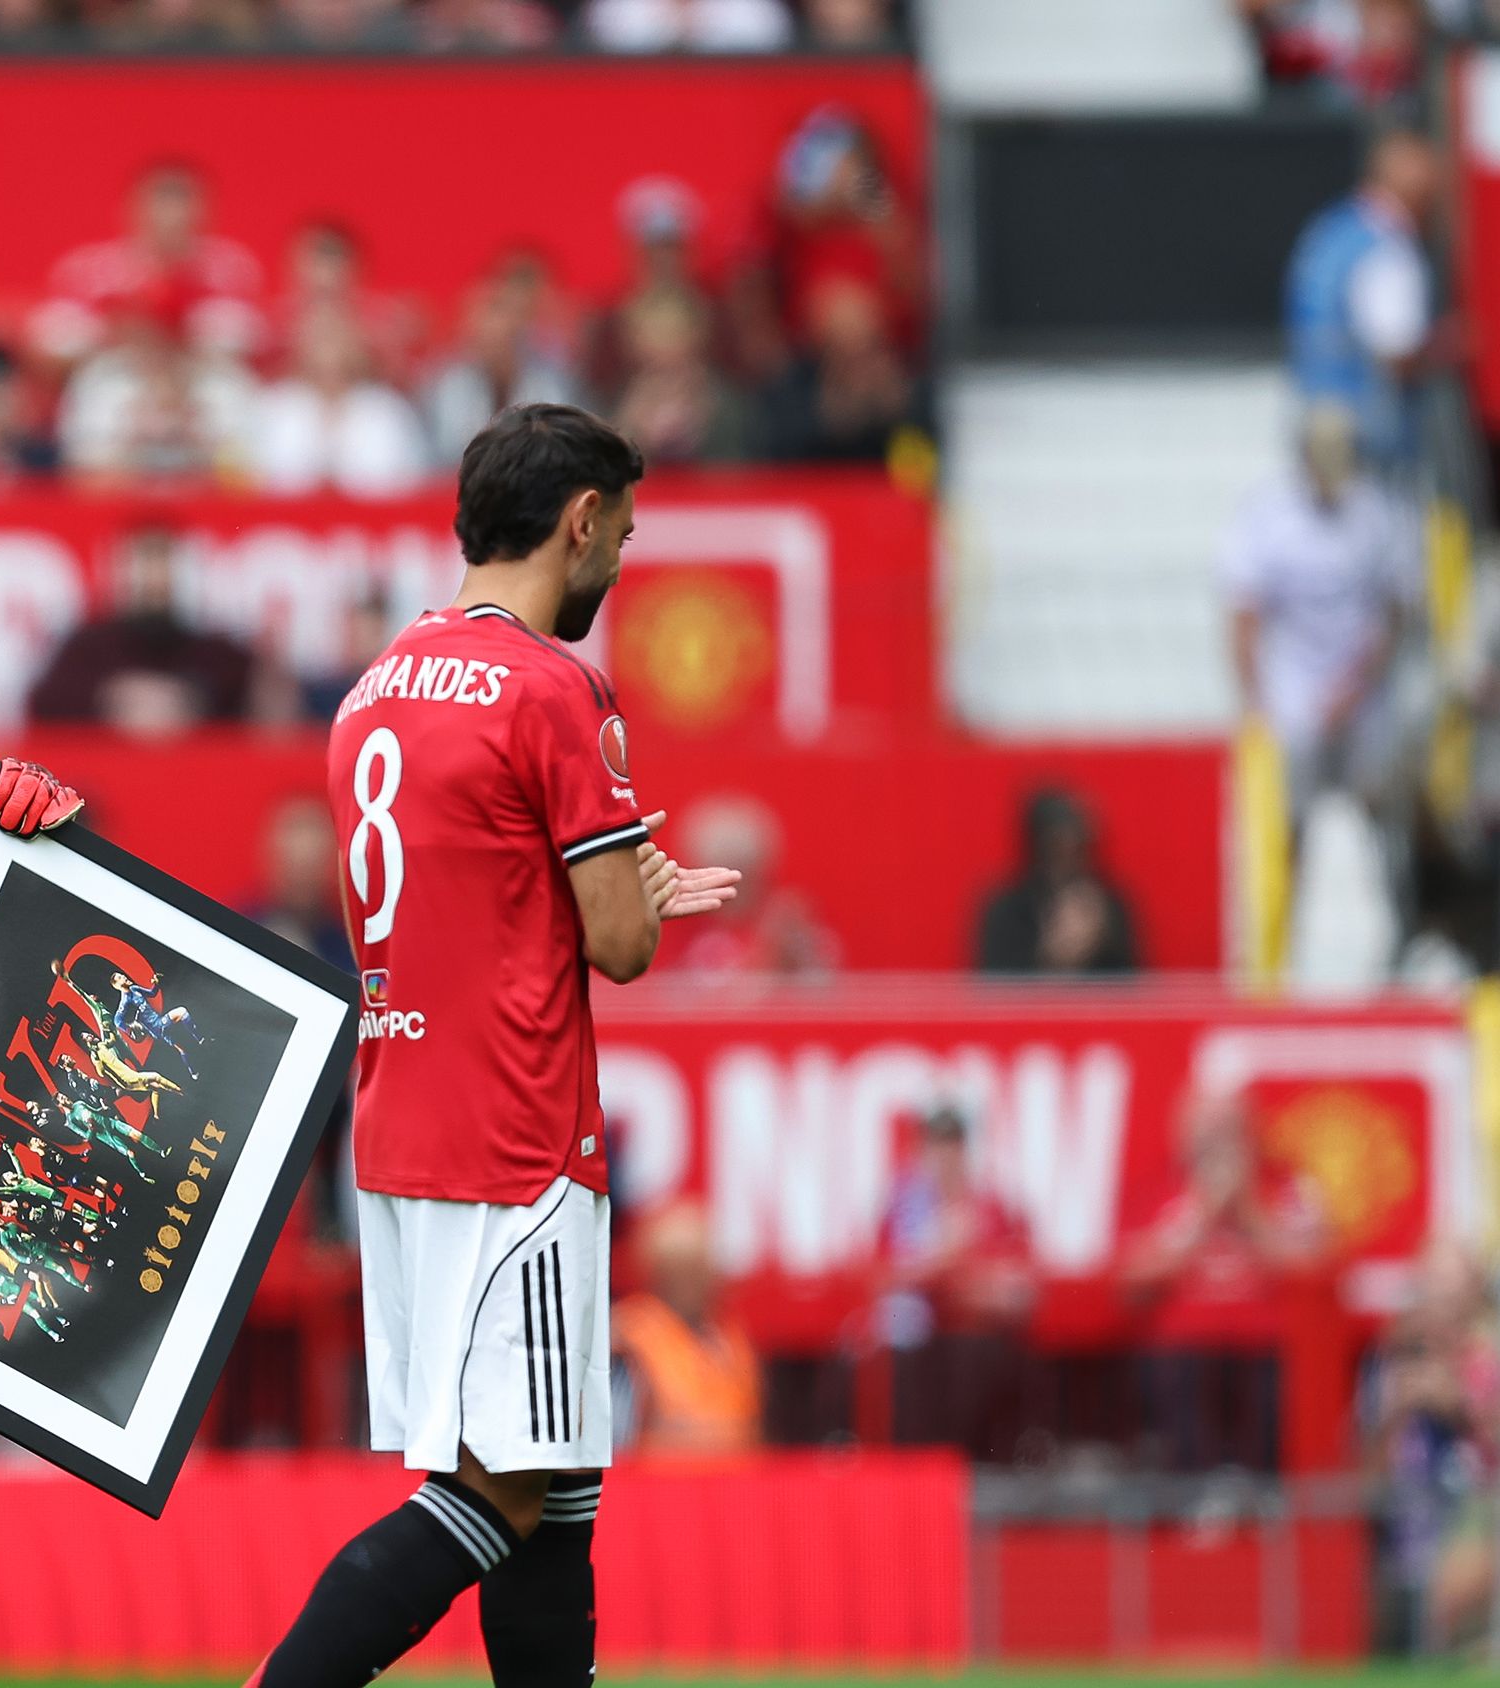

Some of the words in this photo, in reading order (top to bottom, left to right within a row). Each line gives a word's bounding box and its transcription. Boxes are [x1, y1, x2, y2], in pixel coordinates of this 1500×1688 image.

[349, 726, 404, 944] 8
[33, 1012, 57, 1039] You
[710, 1043, 1134, 1276] NOW
